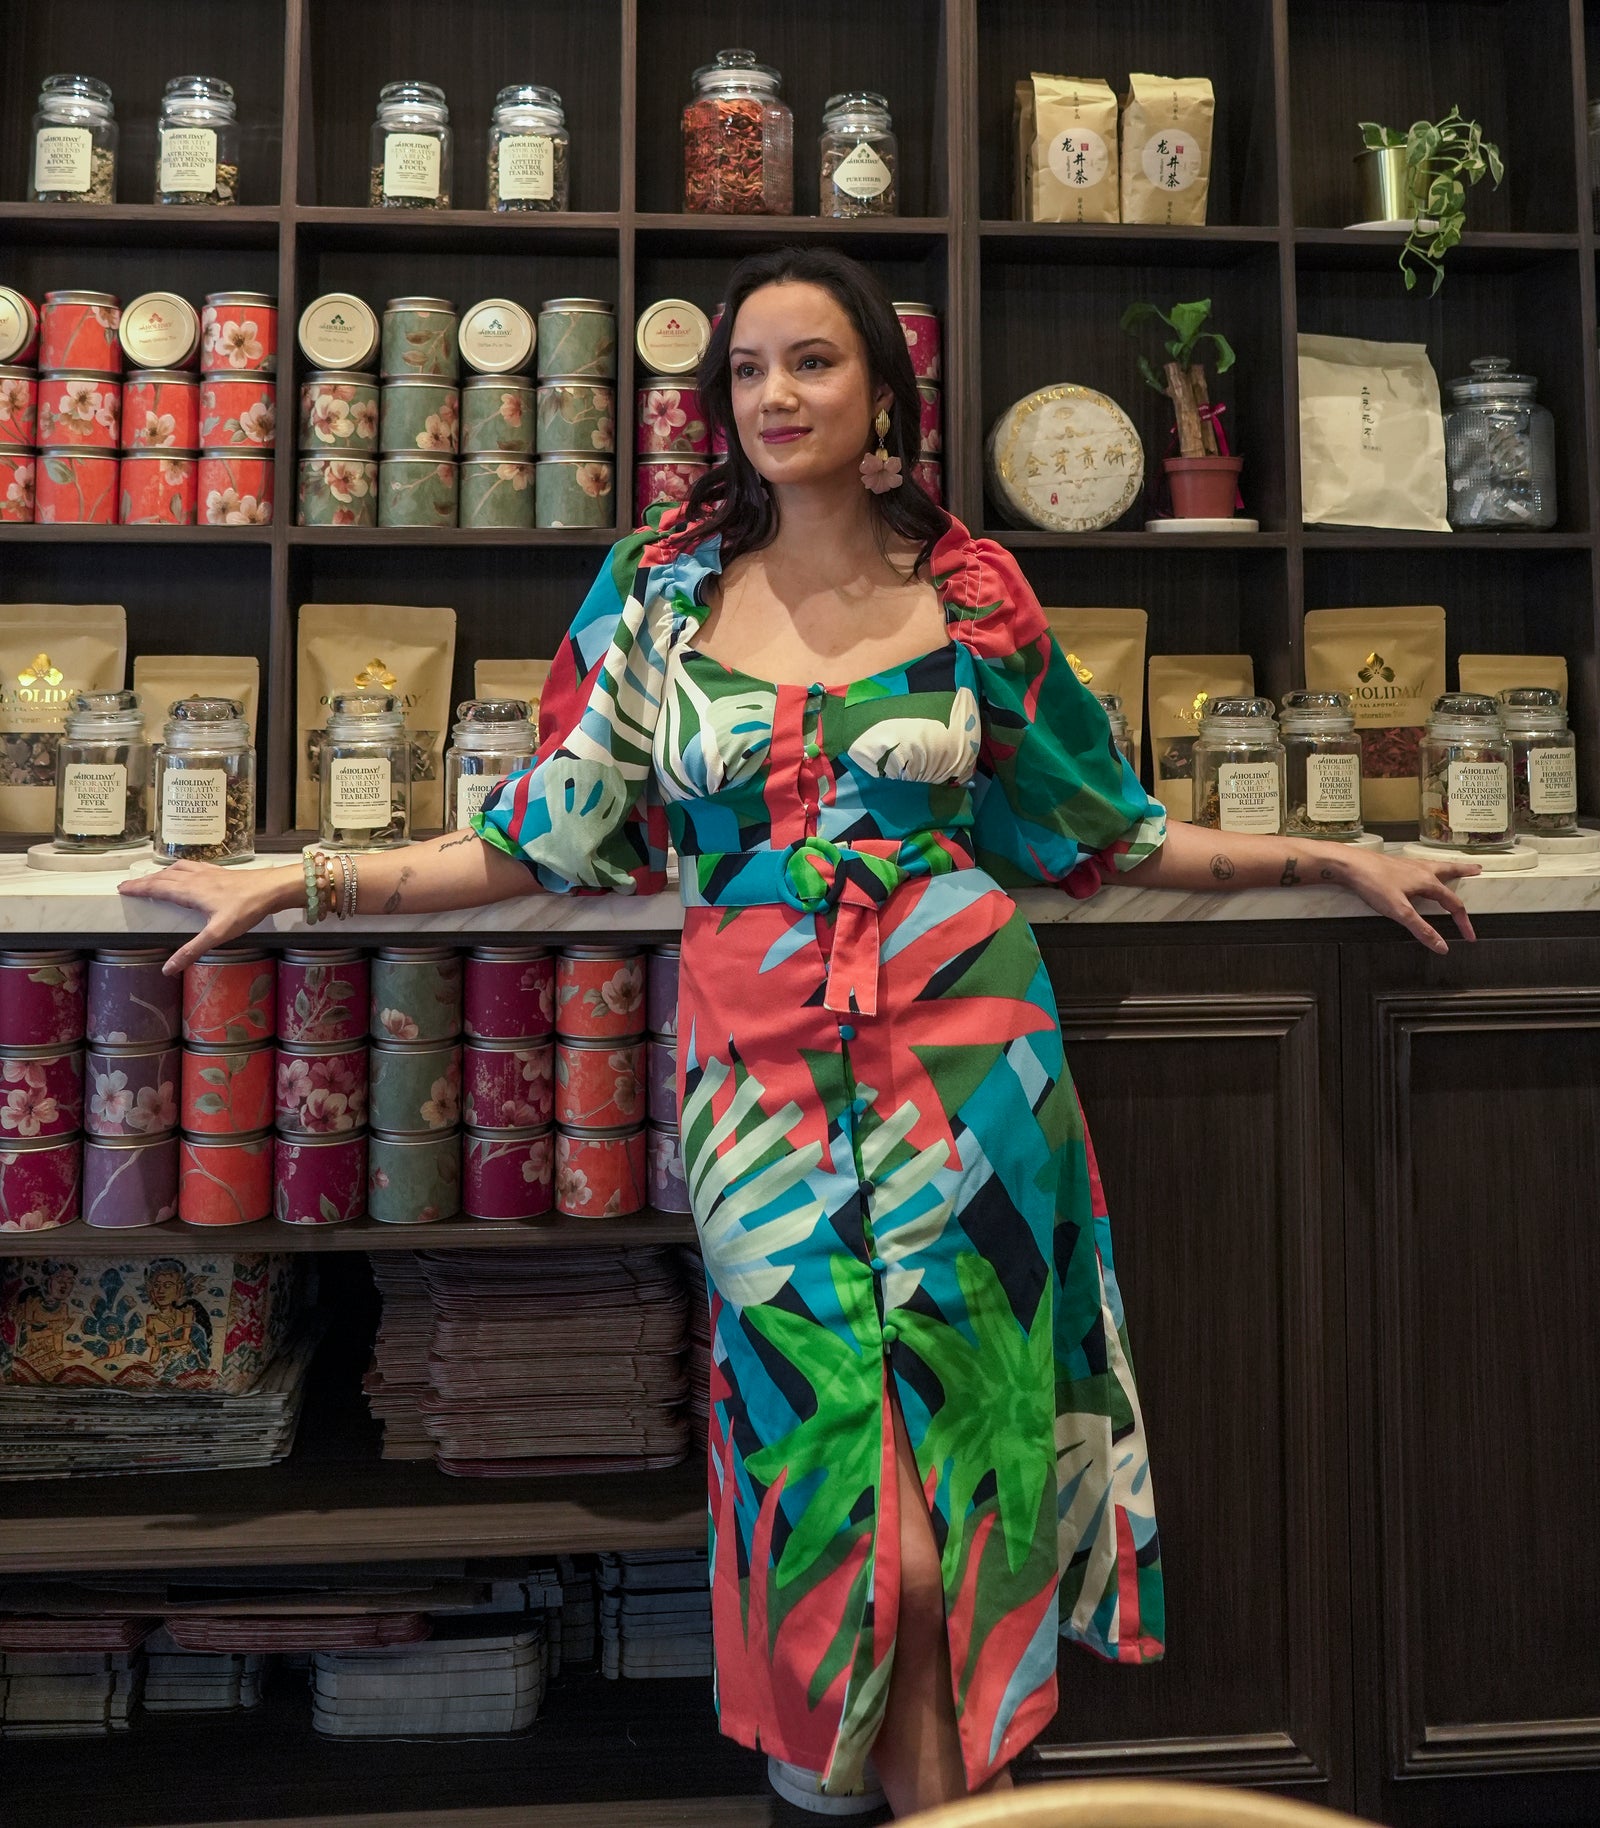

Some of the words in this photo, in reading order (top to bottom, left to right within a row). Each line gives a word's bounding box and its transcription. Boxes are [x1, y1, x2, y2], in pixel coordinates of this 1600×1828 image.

[1061, 137, 1089, 185] 龙井茶
[1156, 139, 1181, 188] 龙井茶
